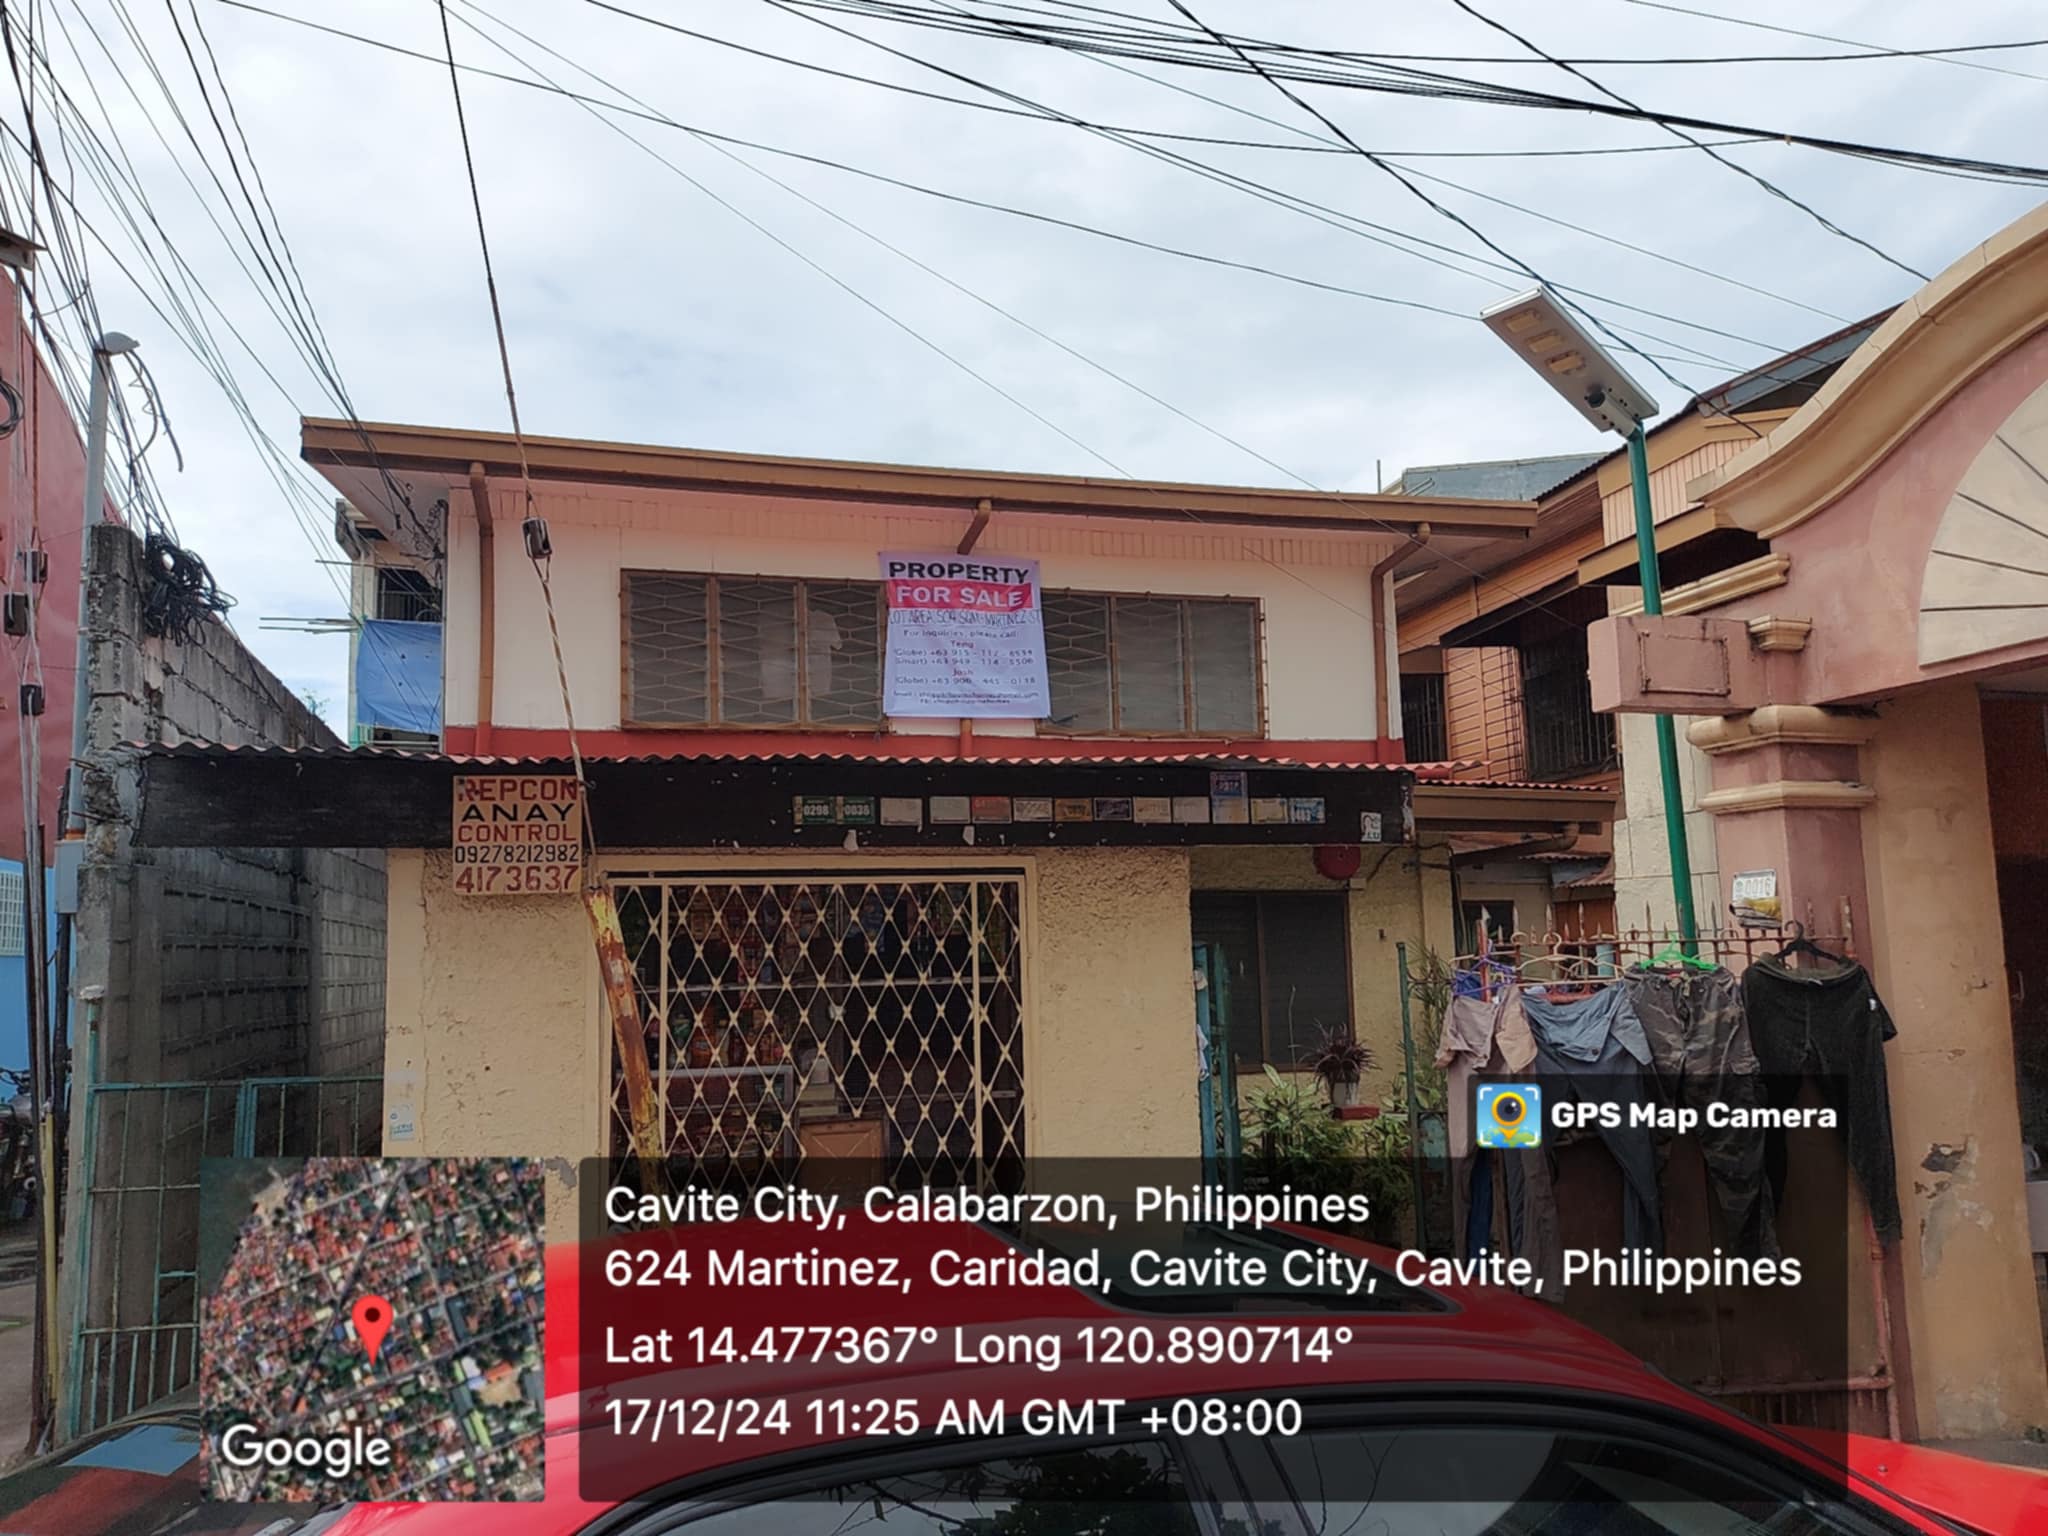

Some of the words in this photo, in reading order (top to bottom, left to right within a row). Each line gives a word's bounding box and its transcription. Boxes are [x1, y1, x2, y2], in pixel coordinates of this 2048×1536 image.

[889, 561, 1029, 584] PROPERTY
[896, 586, 951, 604] FOR
[960, 588, 1025, 608] SALE
[461, 803, 575, 822] ANAY
[458, 823, 577, 842] CONTROL
[455, 844, 579, 864] 09278212982
